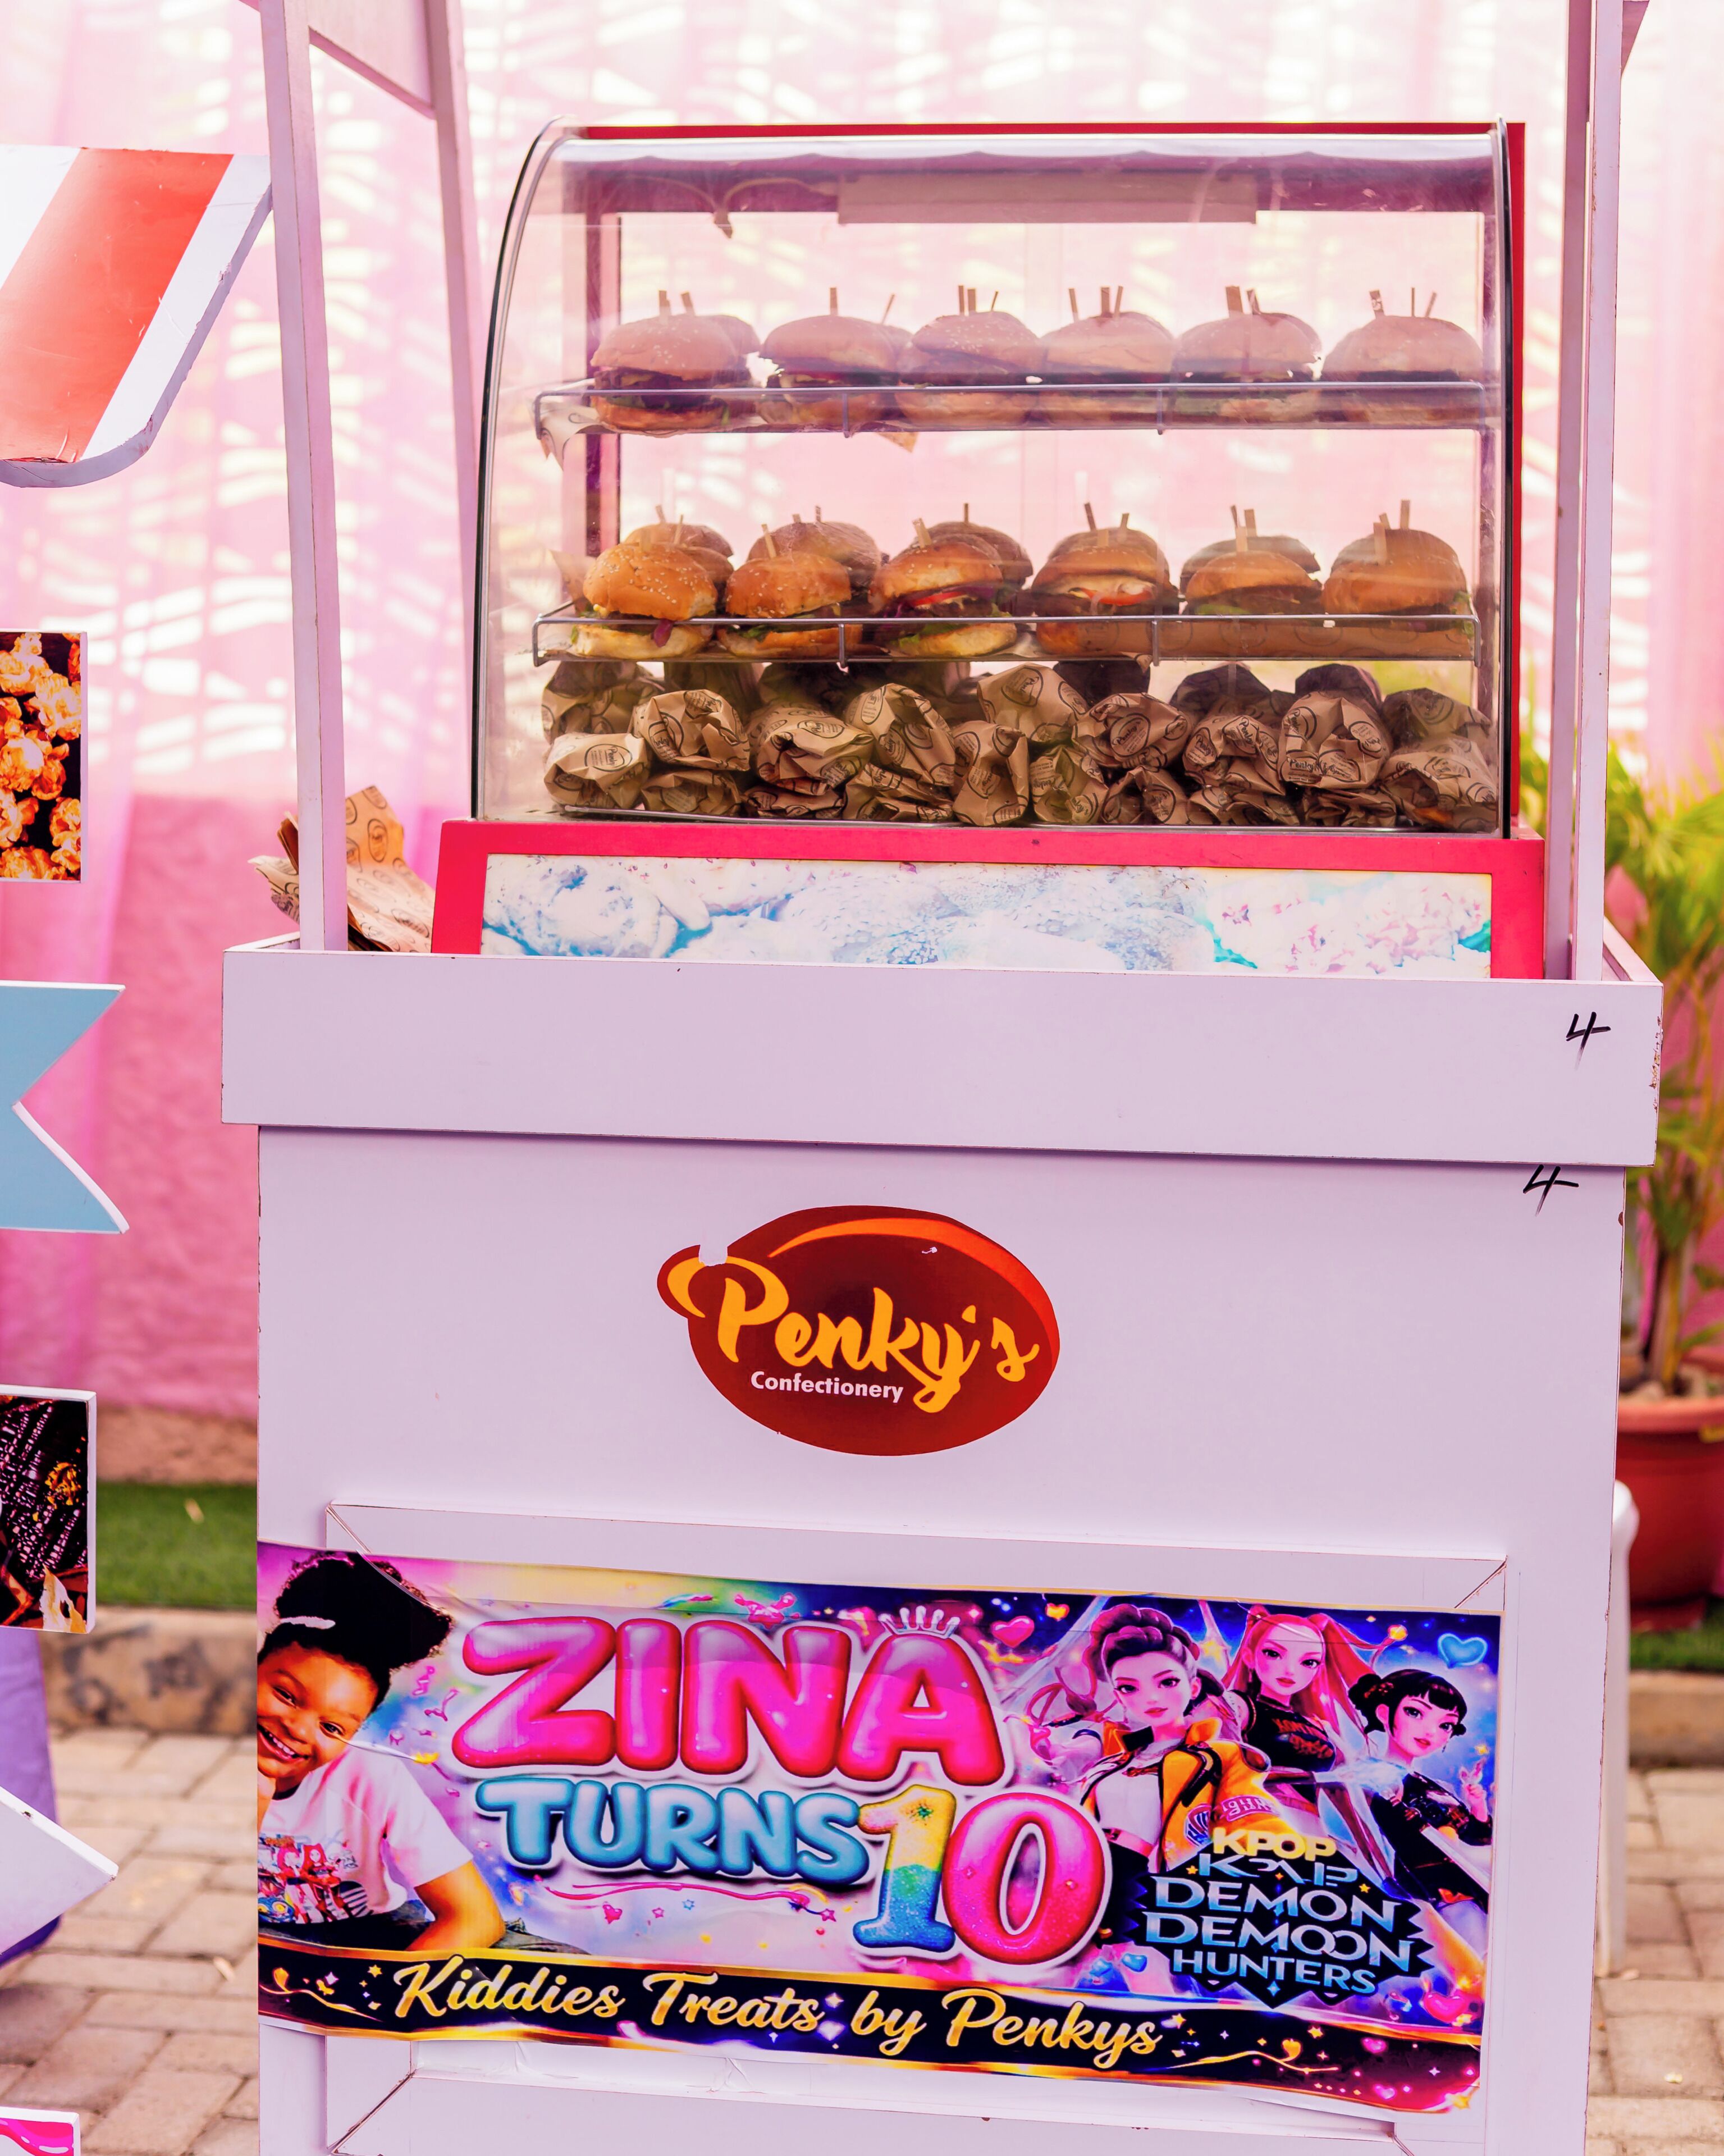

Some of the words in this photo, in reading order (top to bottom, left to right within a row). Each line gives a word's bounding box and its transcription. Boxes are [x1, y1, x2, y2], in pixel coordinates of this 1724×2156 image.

[1566, 1011, 1611, 1070] 4
[1522, 1164, 1579, 1216] 4
[667, 1255, 1040, 1413] Penky's
[751, 1371, 904, 1403] Confectionery
[451, 1615, 1005, 1786] ZINA
[475, 1775, 870, 1885] TURNS
[852, 1784, 1104, 1965] 10
[1213, 1826, 1337, 1861] KPOP
[1150, 1875, 1402, 1931] DEMON
[1173, 1948, 1376, 1994] HUNTERS
[393, 1954, 626, 2018] Kiddies
[642, 1971, 825, 2032] Treats
[850, 1990, 927, 2056] by
[941, 1988, 1163, 2070] Penkys
